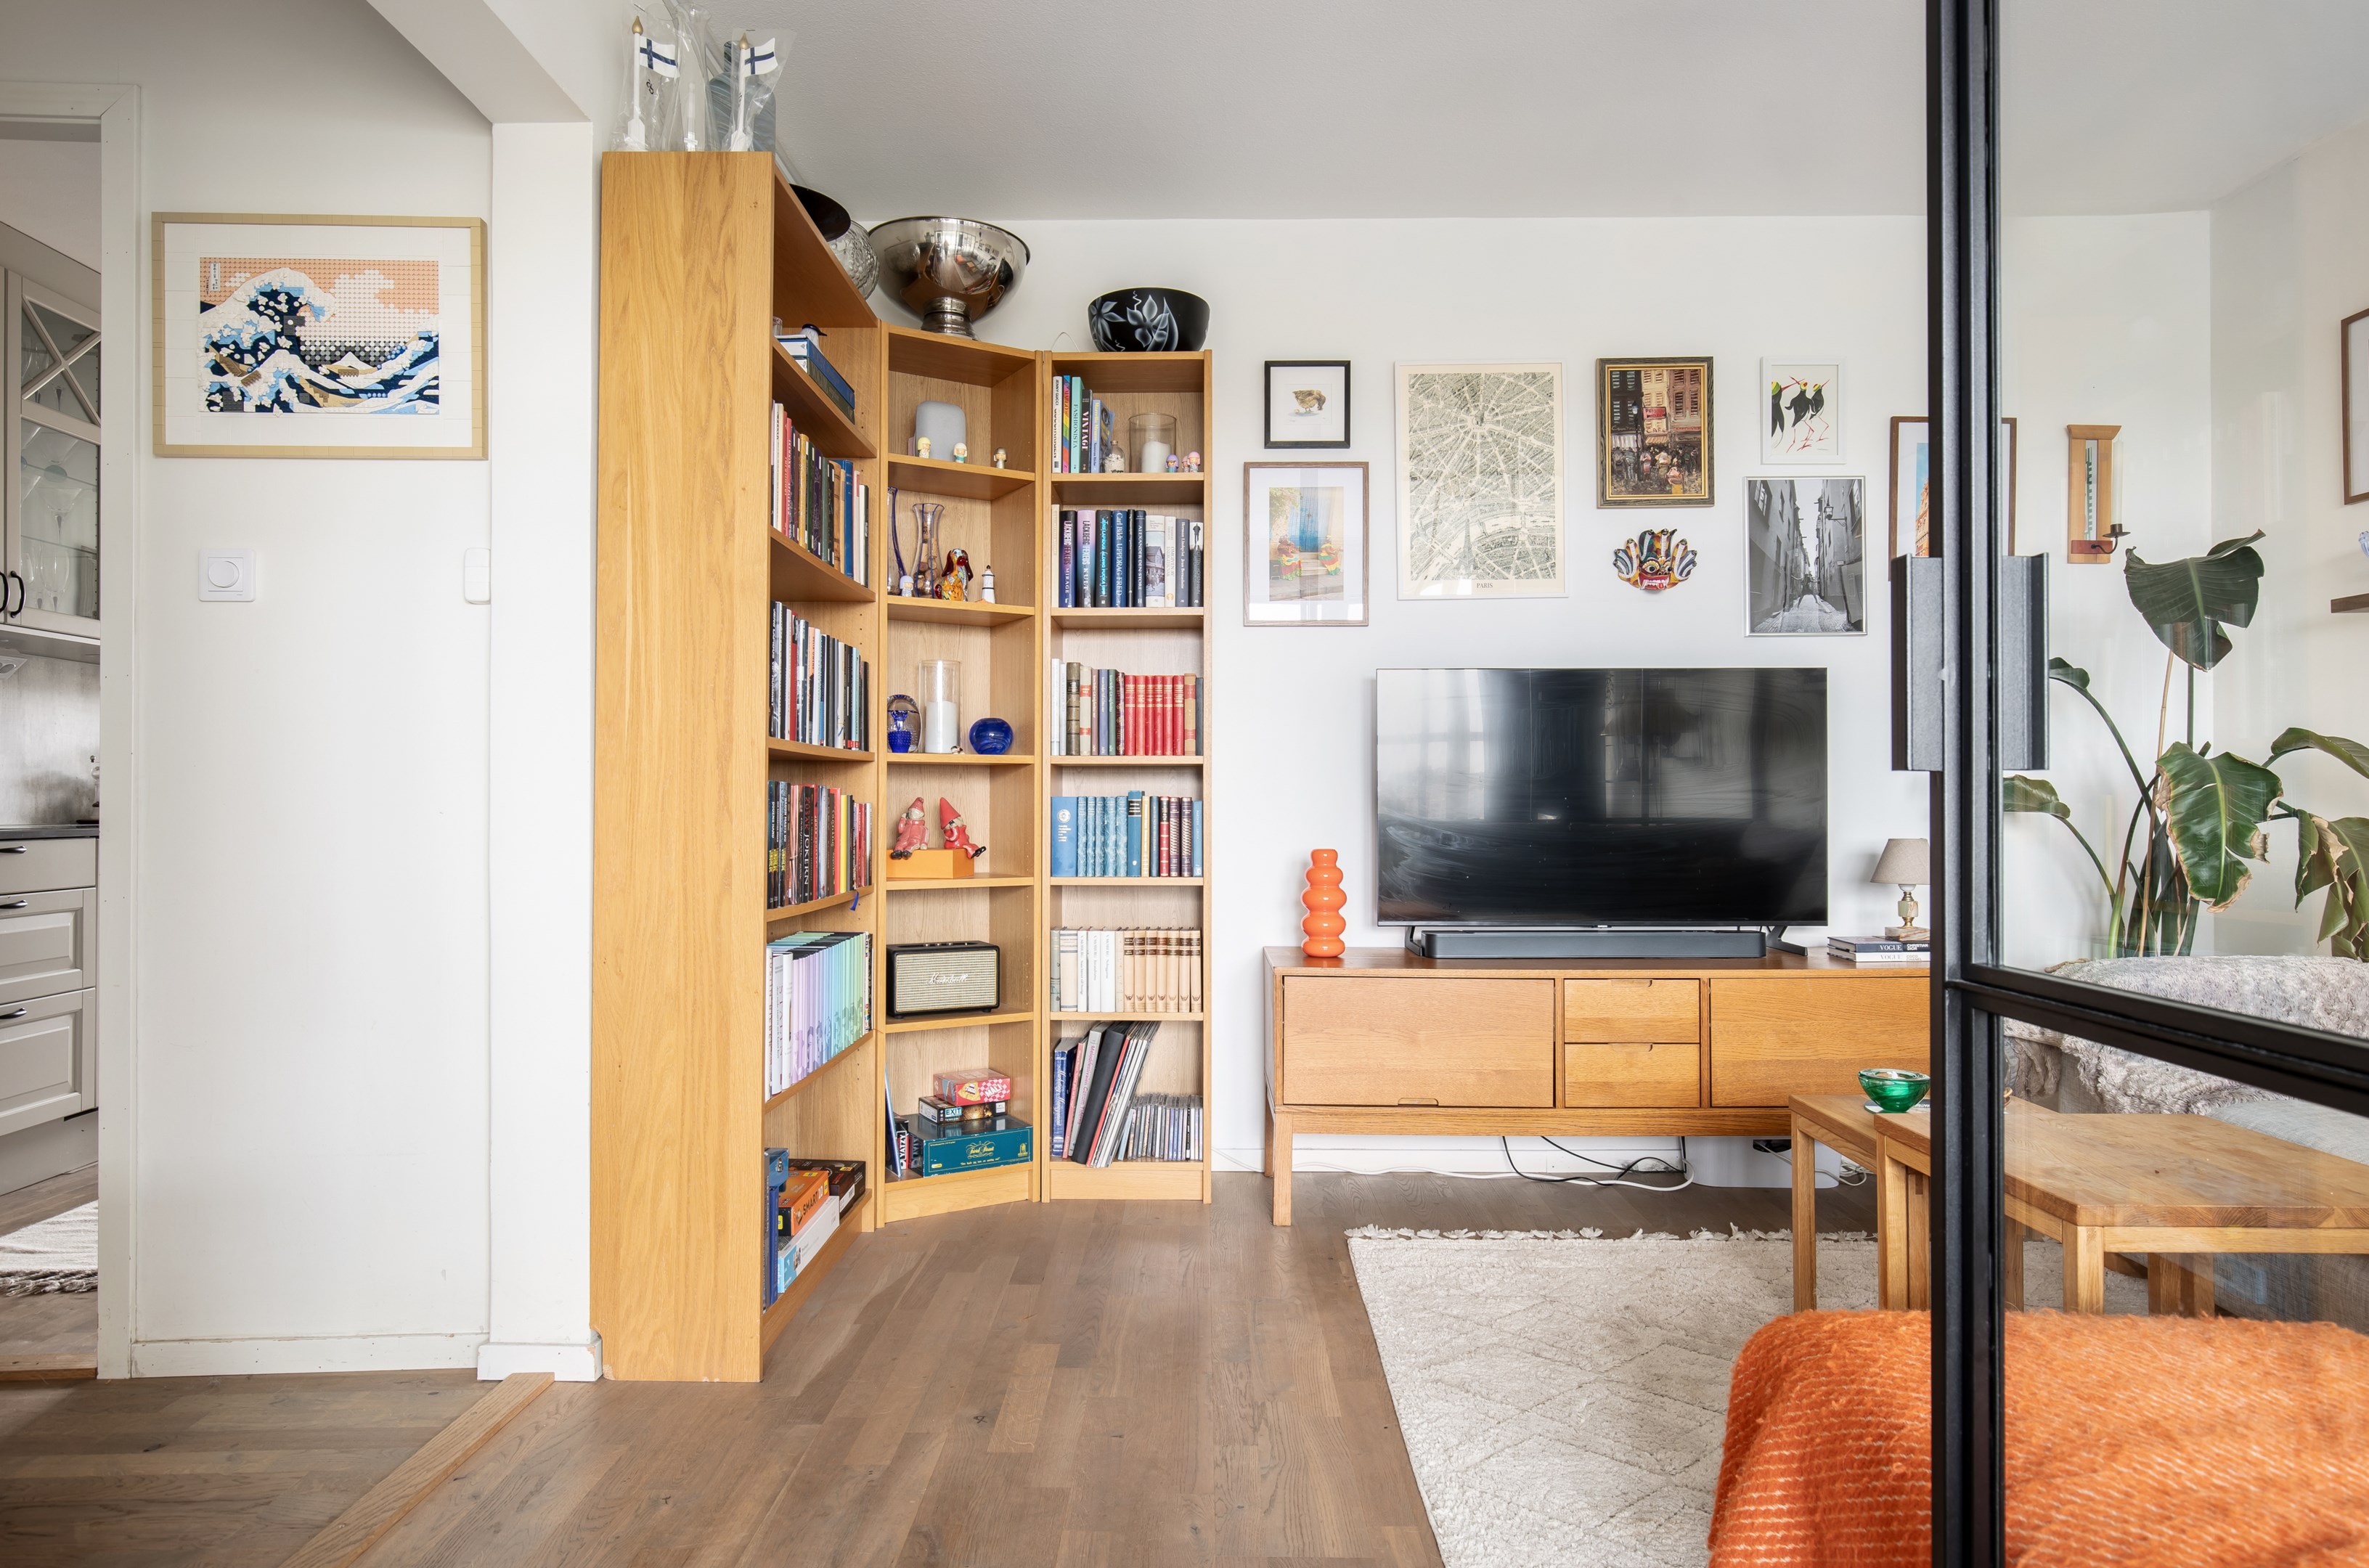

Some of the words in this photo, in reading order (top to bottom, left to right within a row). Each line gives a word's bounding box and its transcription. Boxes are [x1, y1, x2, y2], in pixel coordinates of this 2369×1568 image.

[1064, 520, 1072, 545] LÄCKBERG
[1082, 520, 1091, 544] LÄCKBERG
[928, 972, 969, 984] Marshall
[1084, 1045, 1096, 1085] Melodifestivalen
[1056, 1066, 1066, 1093] Marketing
[1053, 1093, 1064, 1126] Management
[803, 1191, 818, 1214] SMART
[818, 1185, 823, 1199] 10
